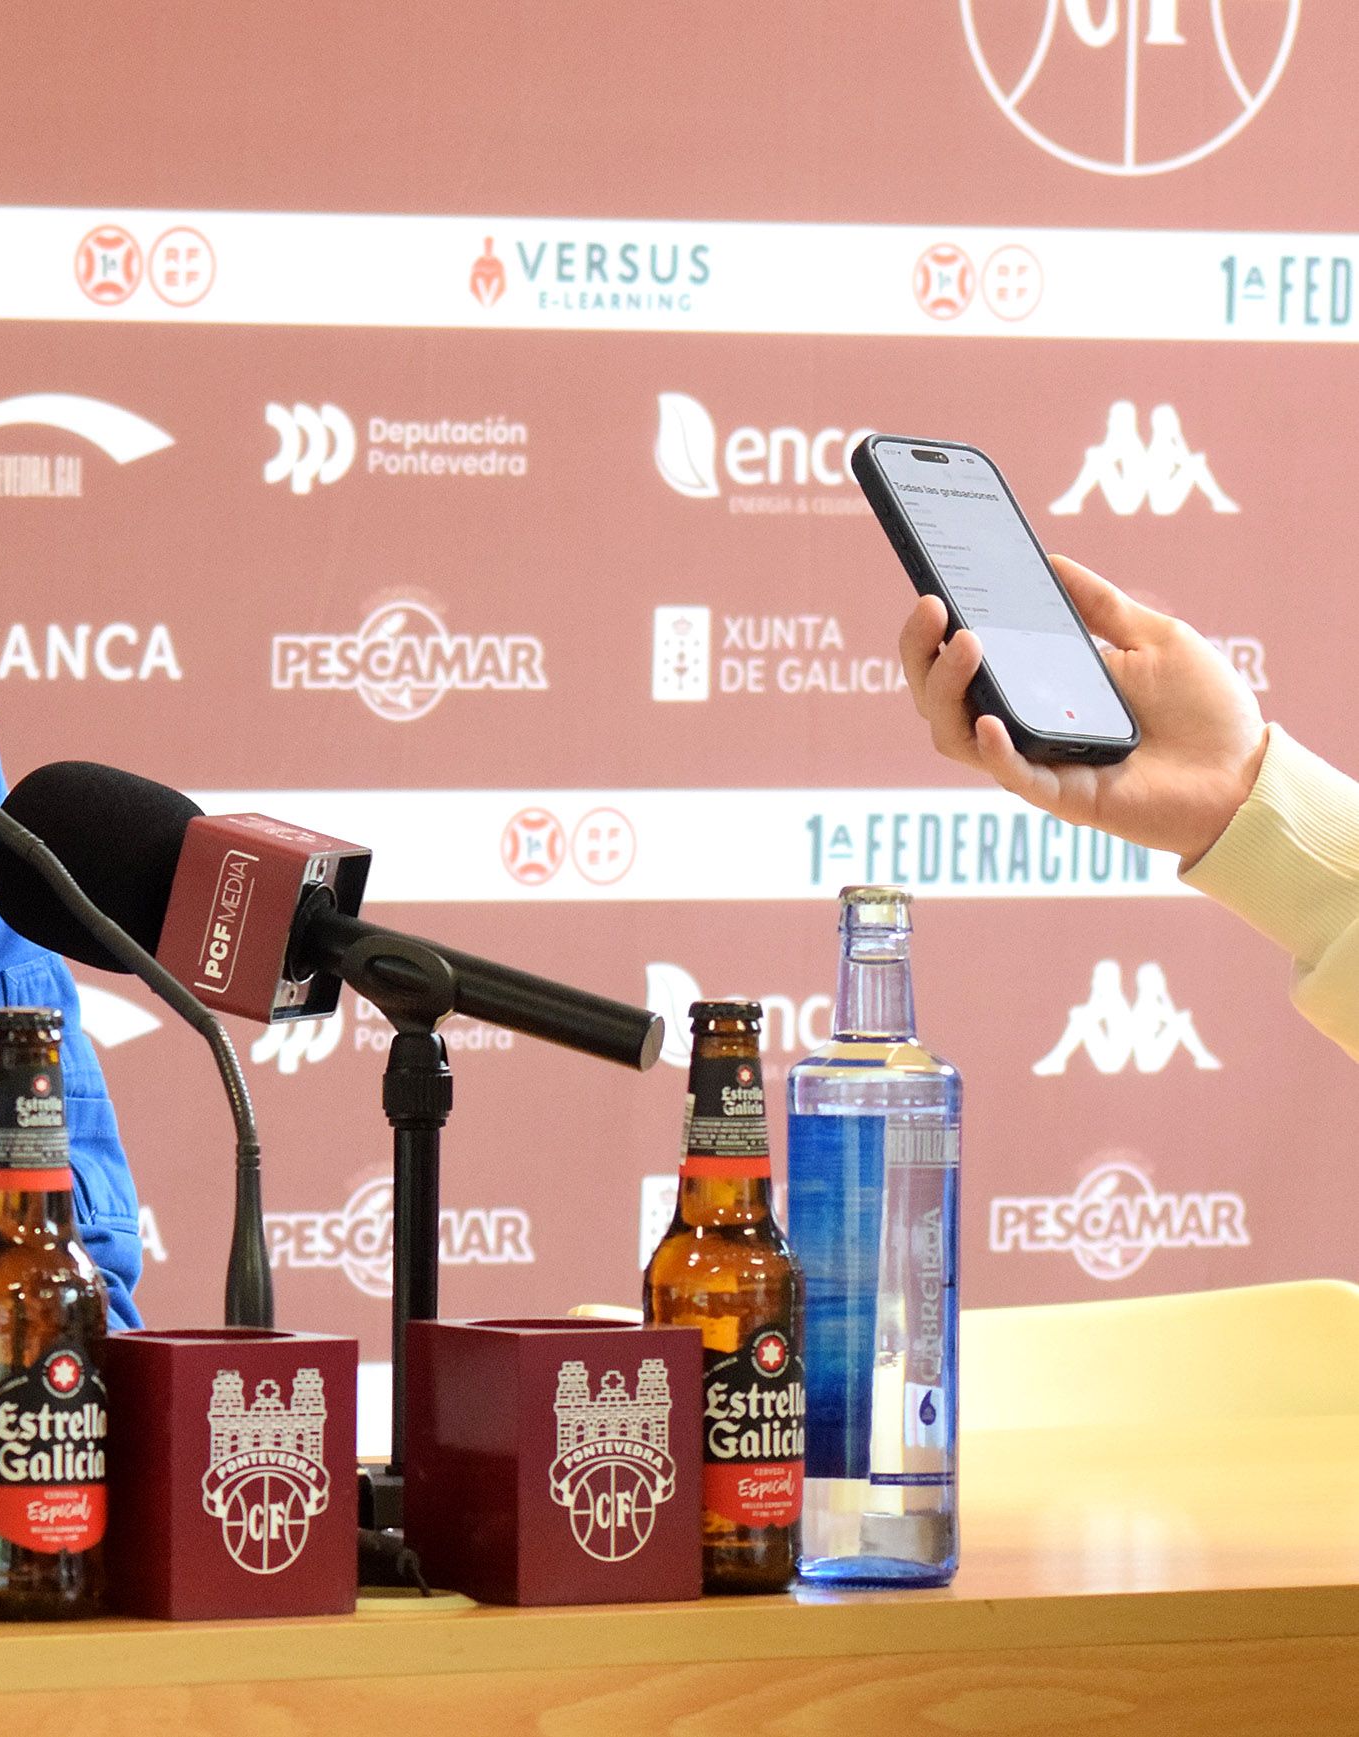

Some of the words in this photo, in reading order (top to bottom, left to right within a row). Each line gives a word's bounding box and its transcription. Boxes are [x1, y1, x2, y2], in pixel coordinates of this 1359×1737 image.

[516, 240, 711, 286] VERSUS
[538, 291, 693, 312] E-LEARNING
[368, 415, 529, 451] Deputación
[367, 449, 528, 477] Pontevedra
[892, 481, 925, 494] Todas
[925, 485, 940, 496] las
[939, 488, 1000, 502] grabaciones
[721, 614, 844, 650] XUNTA
[272, 633, 549, 690] PESCAMAR
[719, 656, 766, 694] DE
[991, 1192, 1250, 1252] PESCAMAR
[215, 1451, 318, 1482] PONTEVEDRA
[563, 1441, 664, 1470] PONTEVEDRA
[247, 1501, 286, 1541] CF
[595, 1489, 633, 1530] CF
